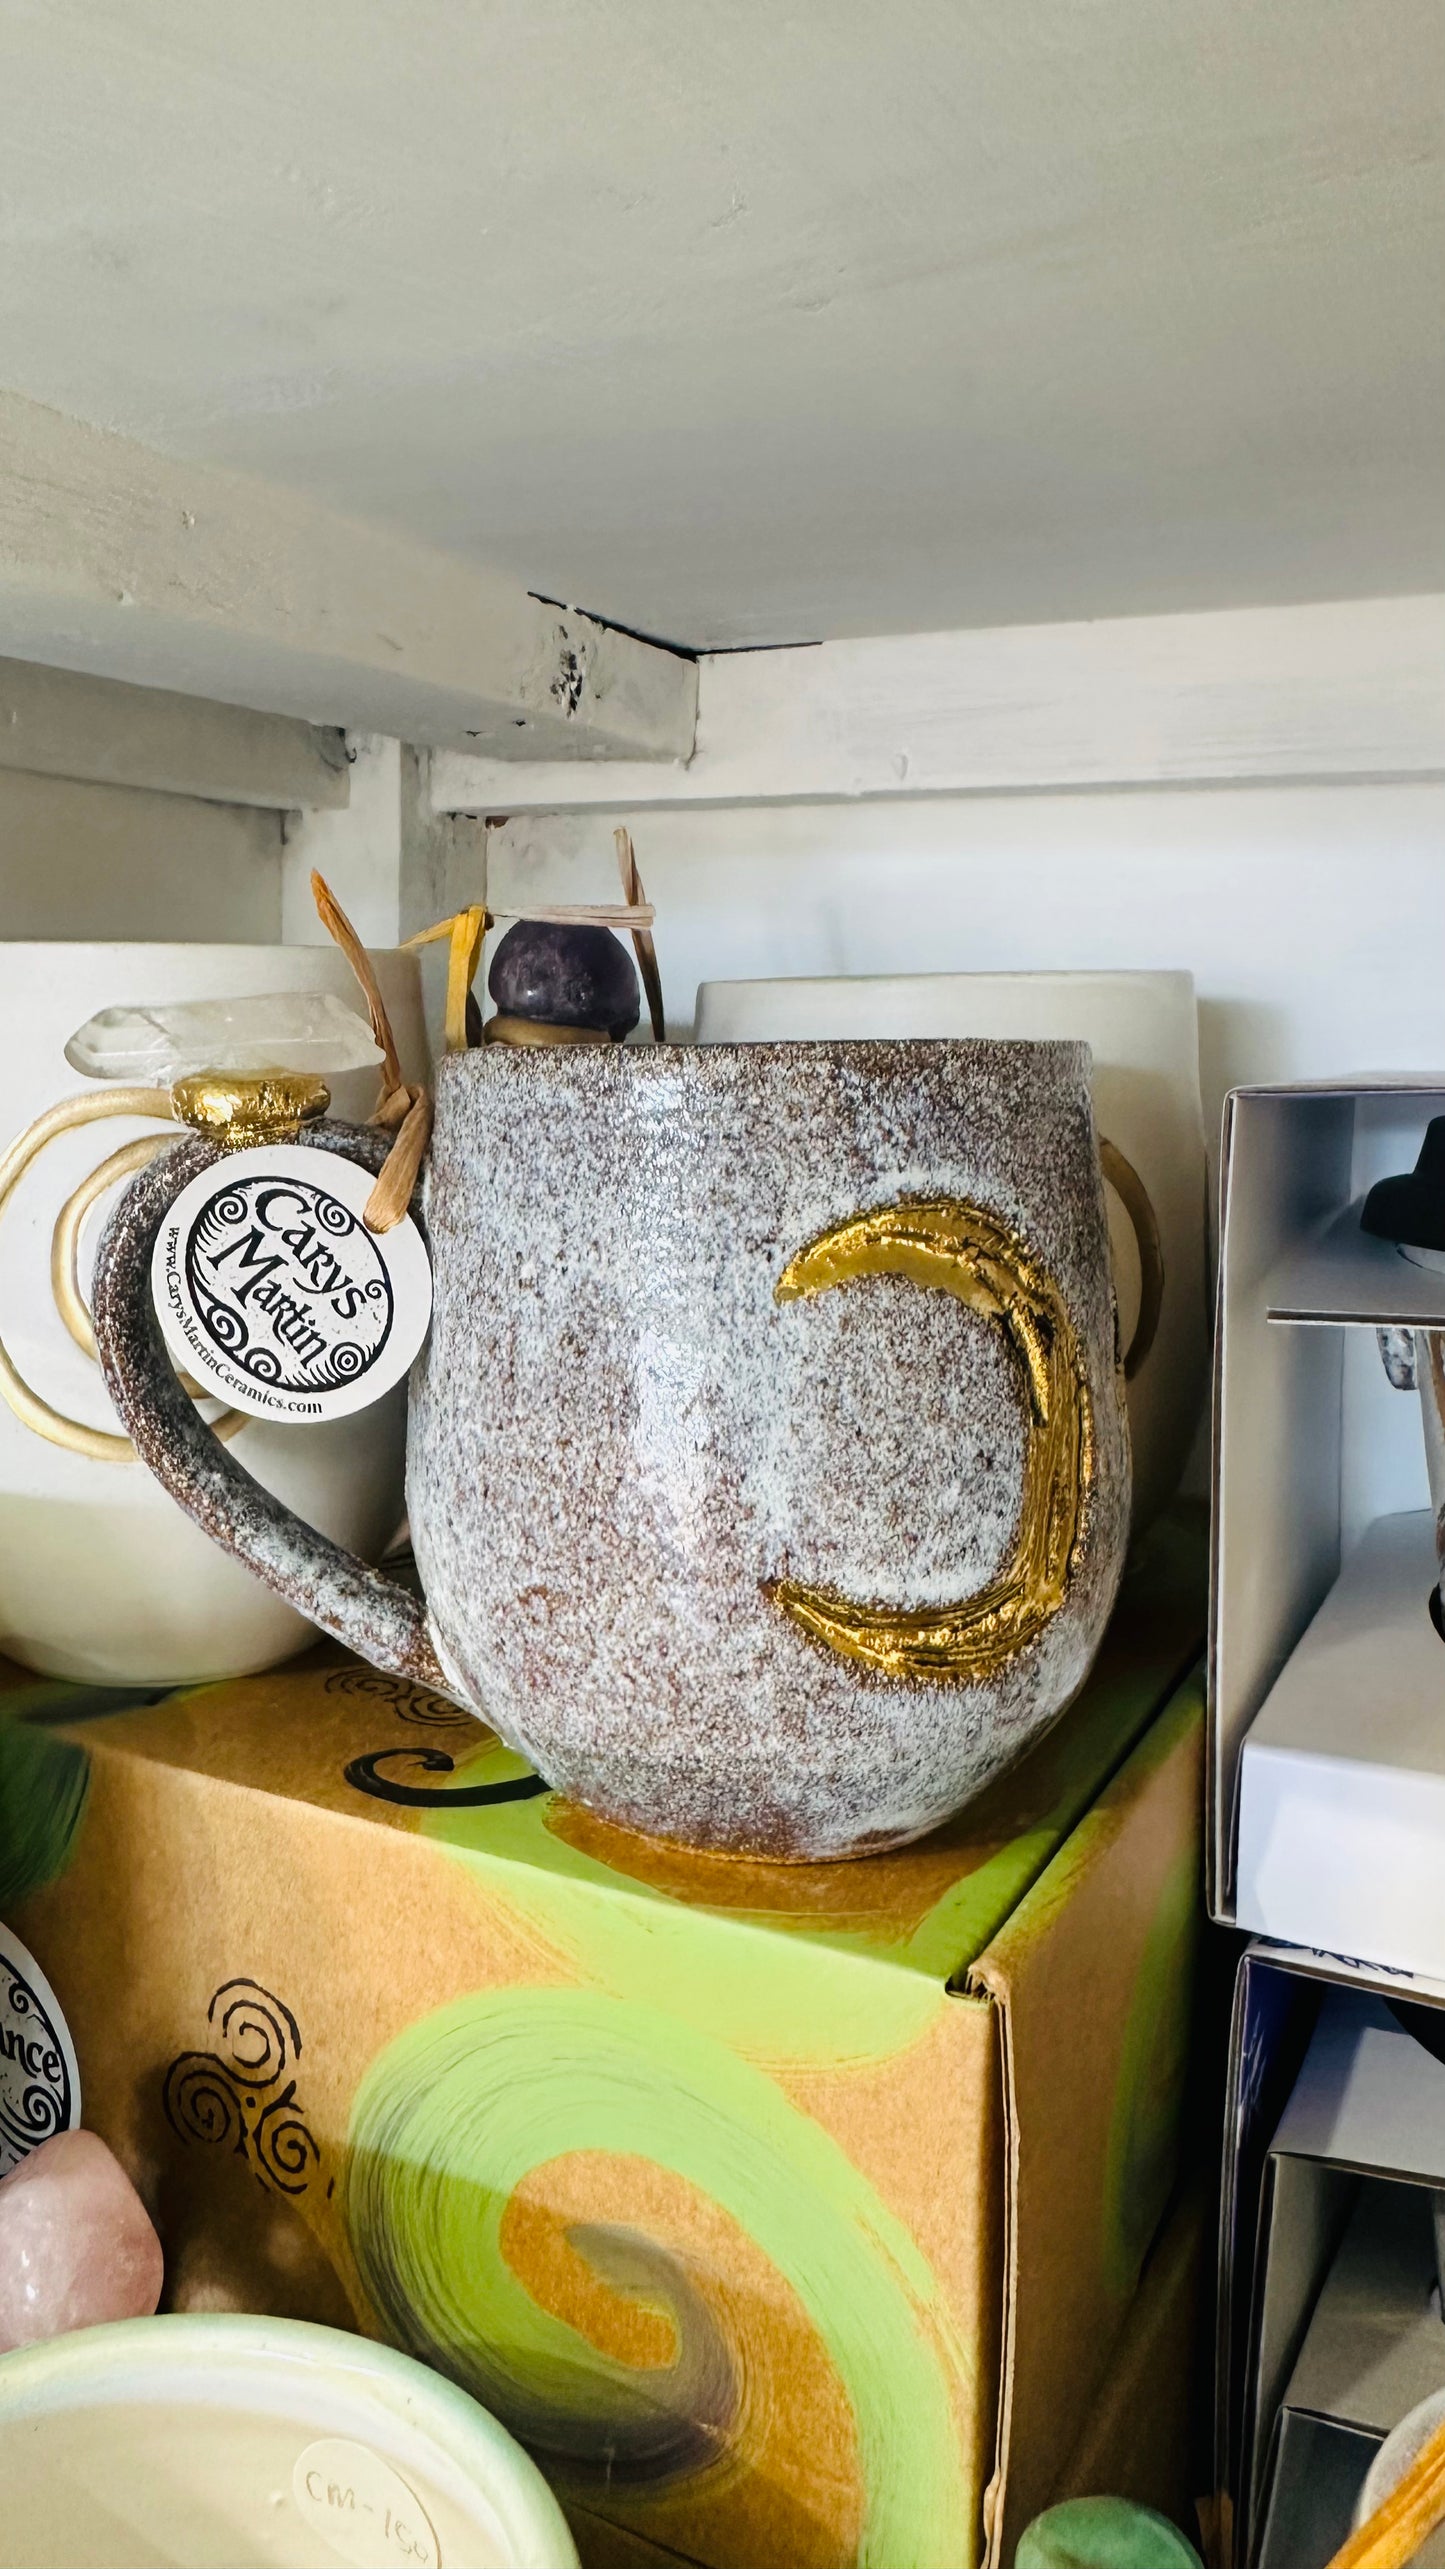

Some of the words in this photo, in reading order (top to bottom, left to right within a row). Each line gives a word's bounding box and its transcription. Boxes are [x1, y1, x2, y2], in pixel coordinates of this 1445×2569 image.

[166, 1227, 323, 1414] www.CarysMartinCeramics.com
[206, 1225, 329, 1370] Martin
[255, 1188, 367, 1319] Carys
[0, 2022, 61, 2082] nce
